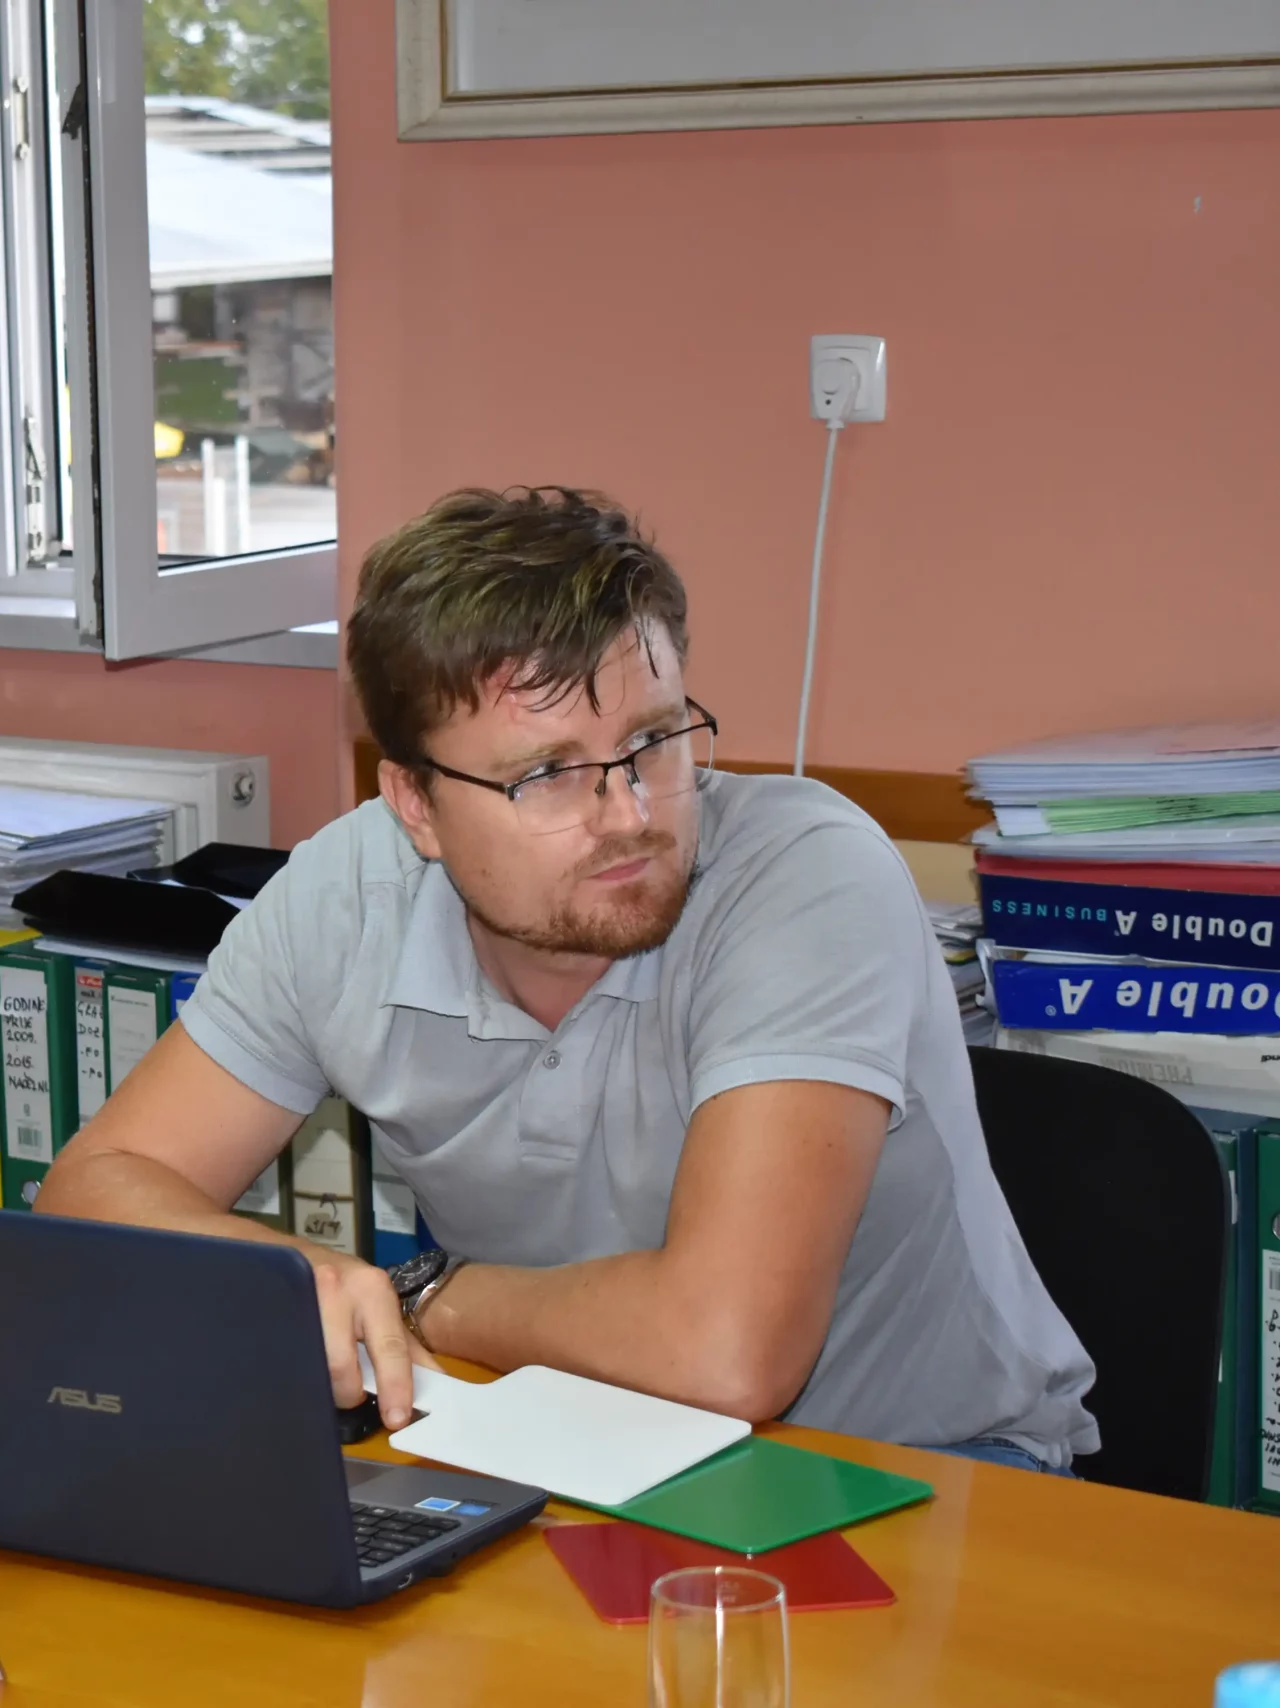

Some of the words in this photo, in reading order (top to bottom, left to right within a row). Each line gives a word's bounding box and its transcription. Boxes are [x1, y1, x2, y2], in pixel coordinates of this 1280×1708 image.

[992, 899, 1107, 922] BUSINESS
[1151, 912, 1273, 947] Double
[3, 996, 46, 1013] GODINE
[1116, 979, 1280, 1018] ouble
[47, 1386, 122, 1414] ASUS
